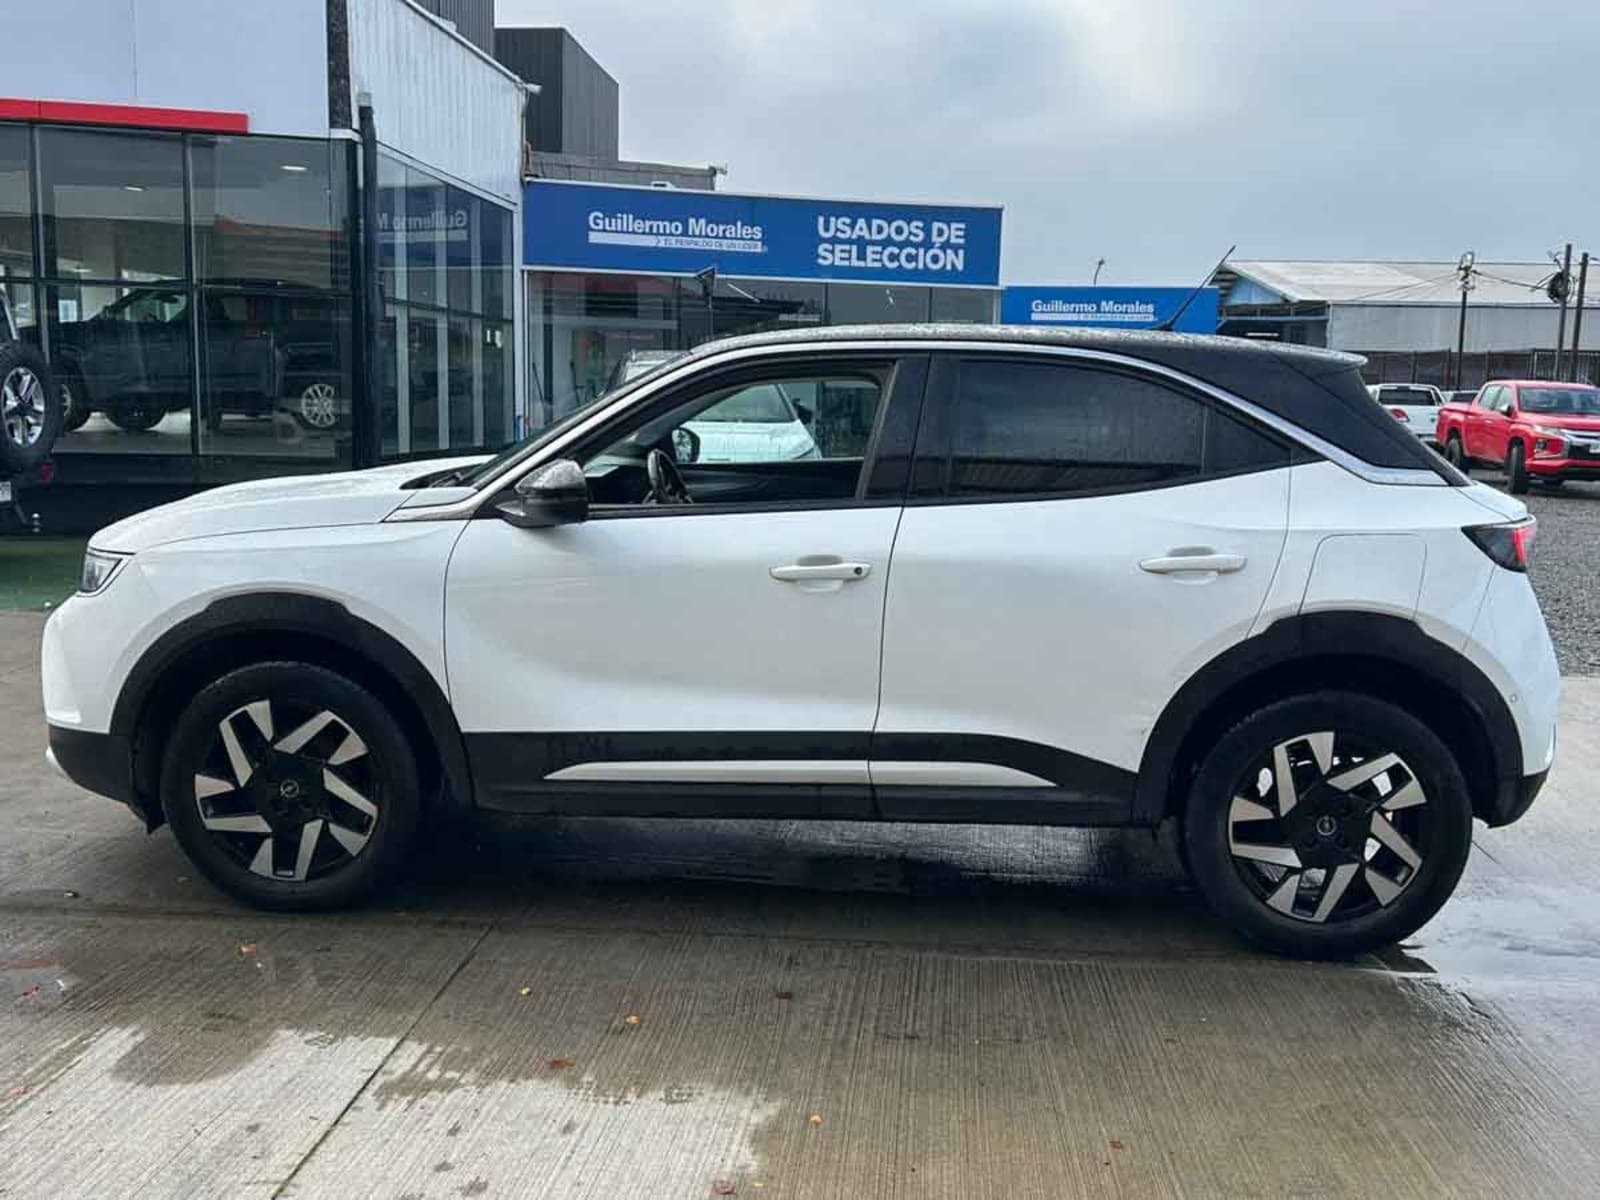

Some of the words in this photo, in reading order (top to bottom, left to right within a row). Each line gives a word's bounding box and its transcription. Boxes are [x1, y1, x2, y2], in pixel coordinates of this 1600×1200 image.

[588, 211, 683, 235] Guillermo
[688, 218, 762, 239] Morales
[817, 216, 924, 242] USADOS
[931, 221, 966, 244] DE
[817, 243, 965, 271] SELECCIÓN
[1031, 300, 1097, 312] Guillermo
[1100, 301, 1154, 313] Morales
